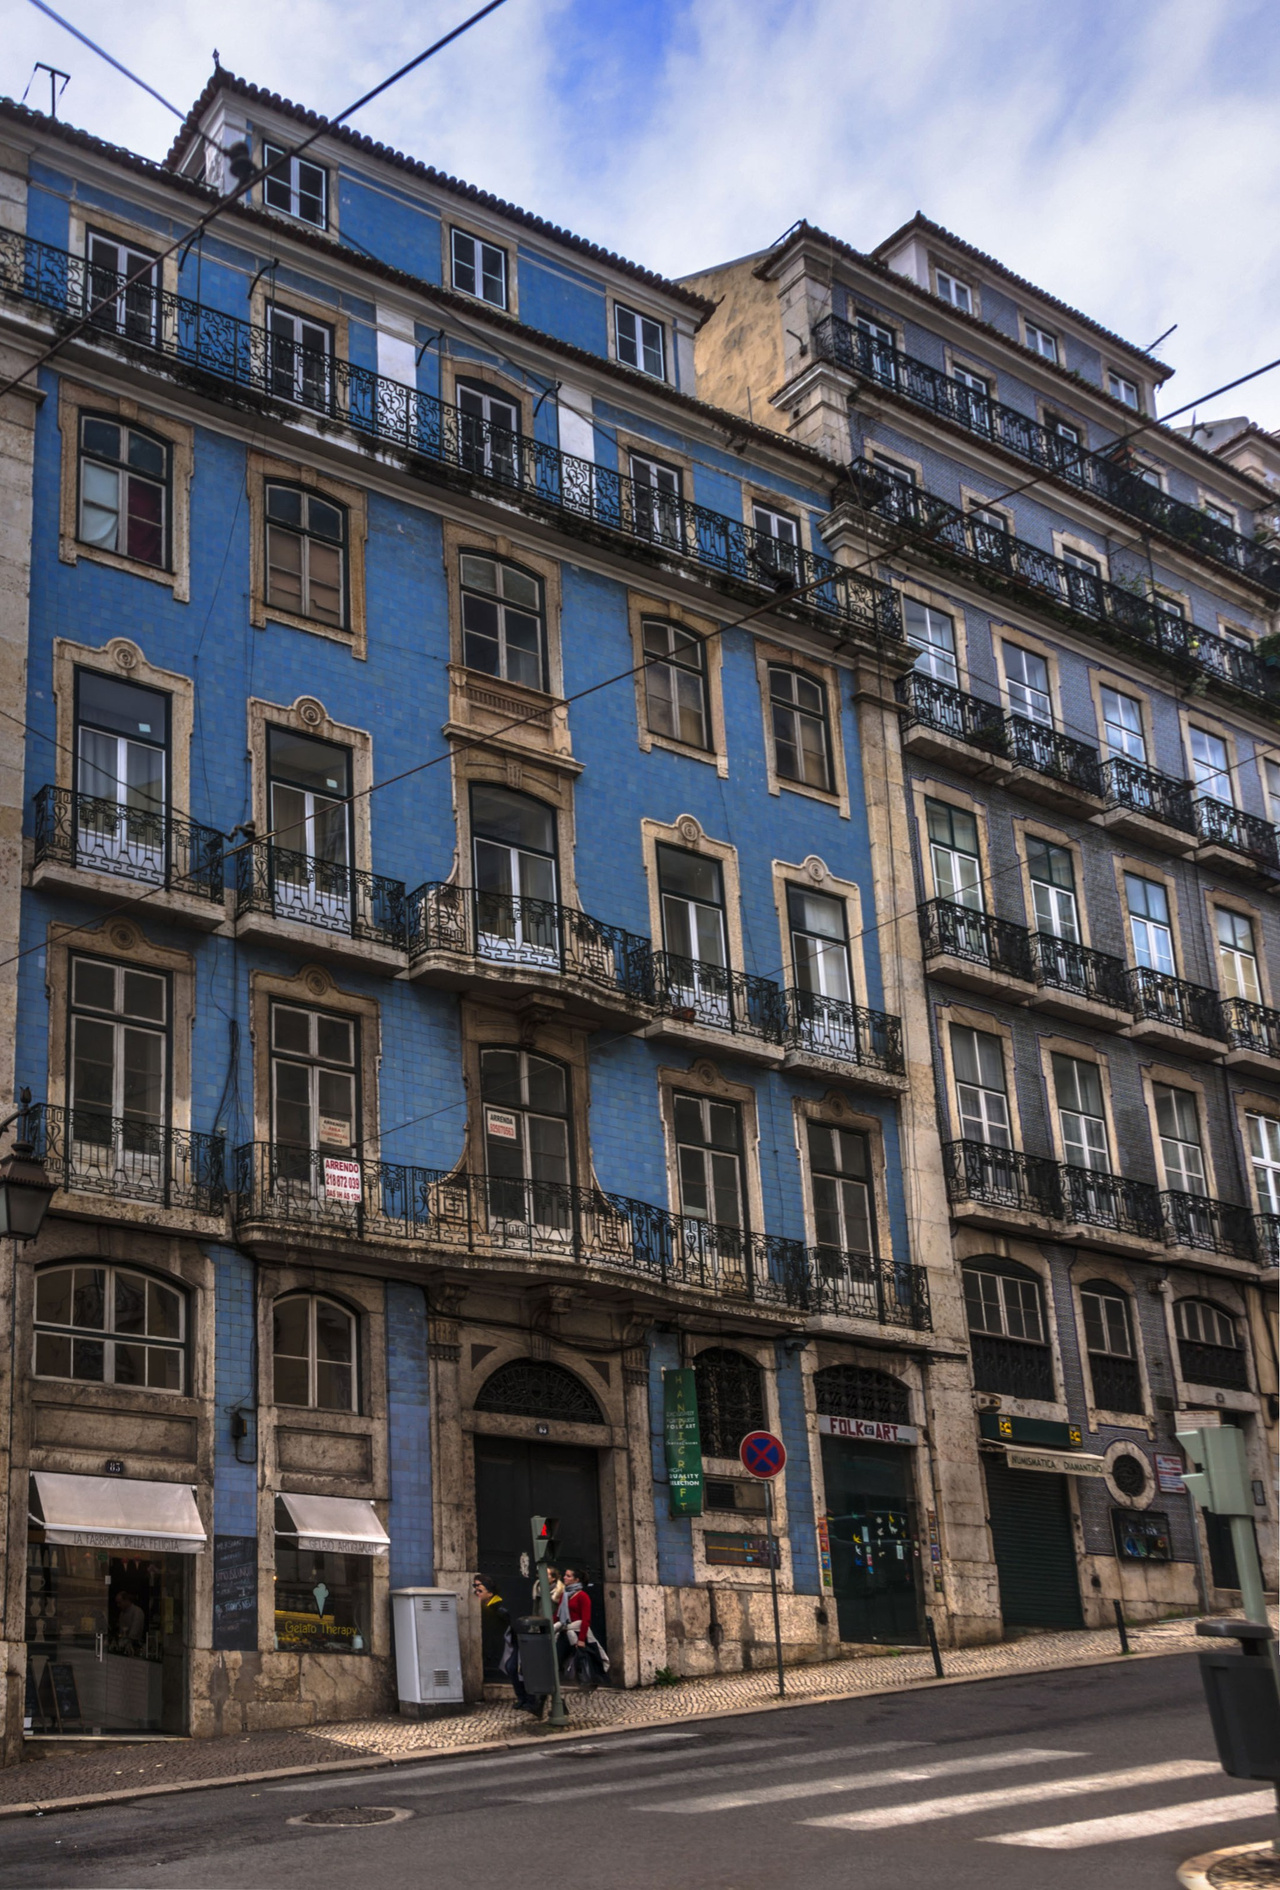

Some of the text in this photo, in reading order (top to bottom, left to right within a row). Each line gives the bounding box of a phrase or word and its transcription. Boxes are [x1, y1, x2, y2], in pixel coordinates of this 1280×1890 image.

[325, 1159, 359, 1173] ARRENDO
[830, 1417, 899, 1441] FOLK ART
[1063, 1461, 1103, 1474] DIAMANTINO
[73, 1533, 83, 1545] LA
[86, 1534, 122, 1547] FABBRICA
[309, 1539, 334, 1551] GELATO
[284, 1620, 358, 1637] Gelato Therapy
